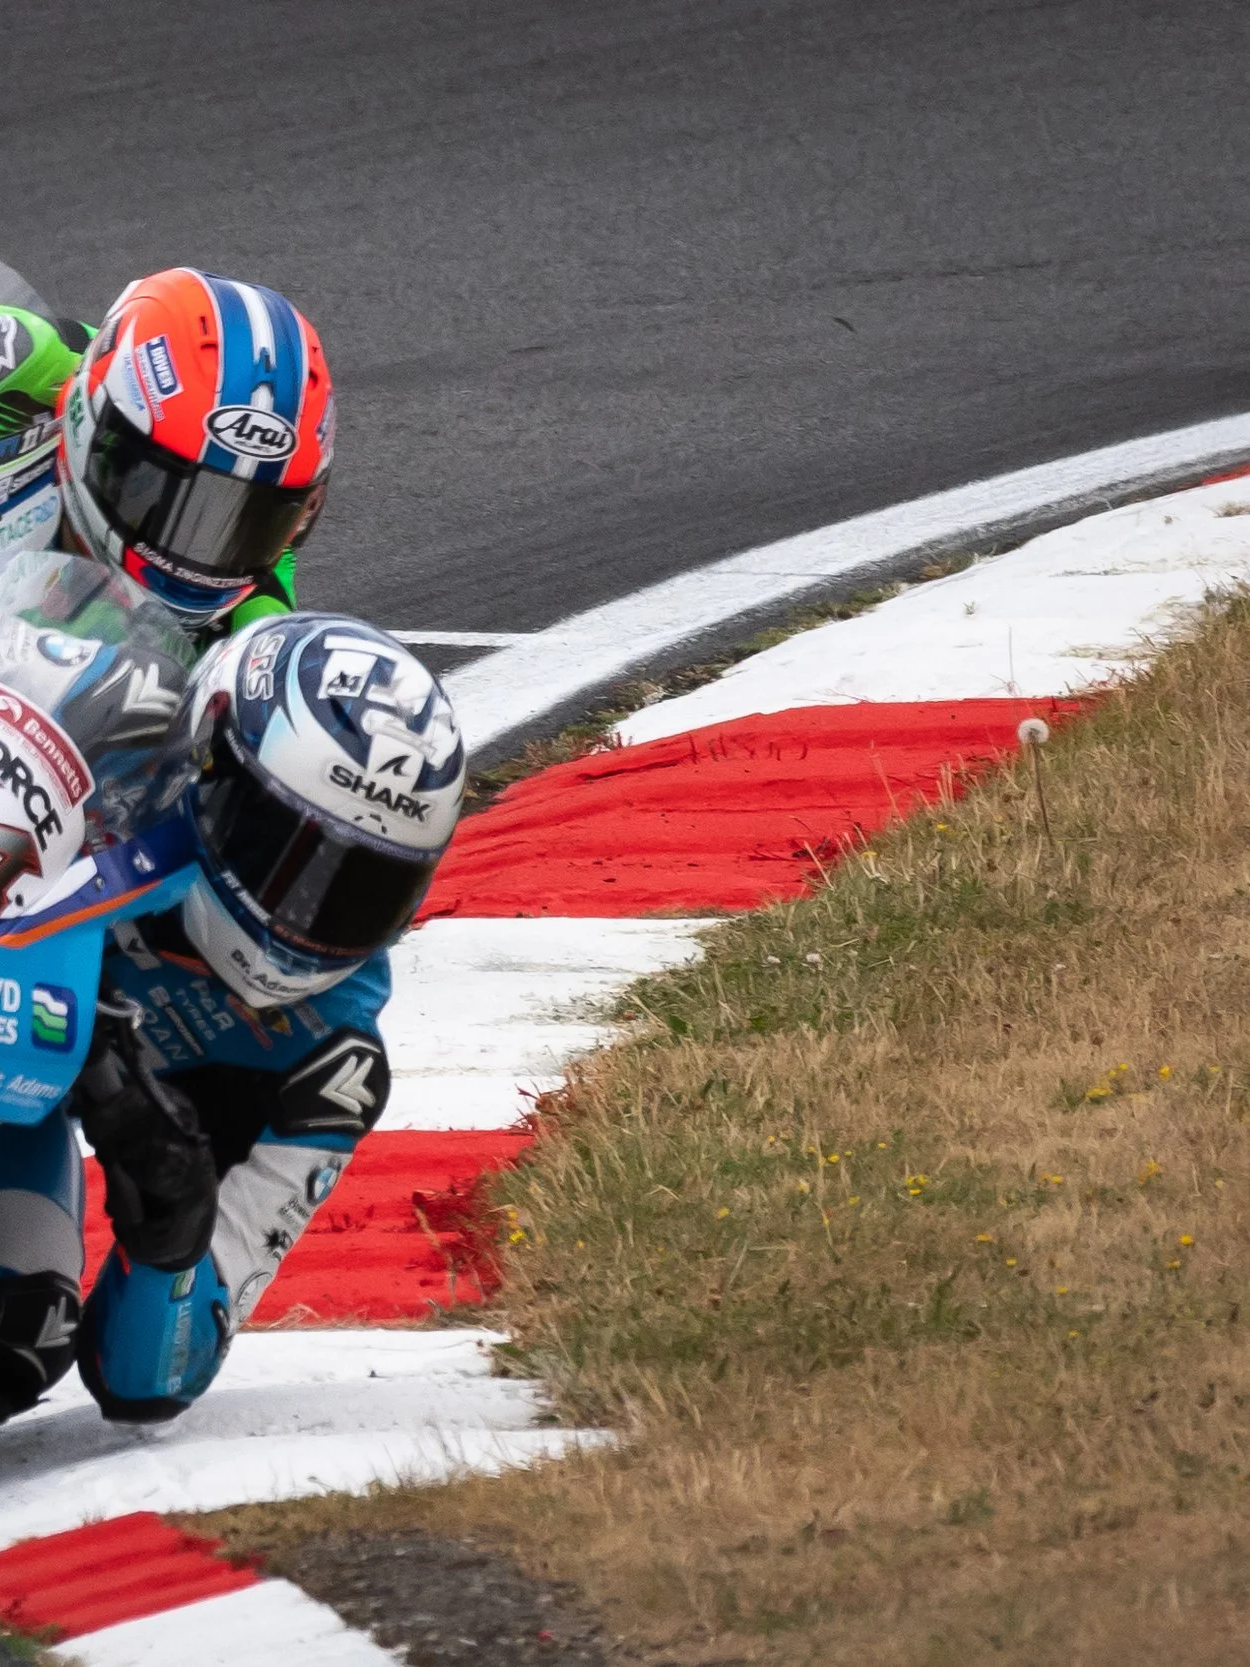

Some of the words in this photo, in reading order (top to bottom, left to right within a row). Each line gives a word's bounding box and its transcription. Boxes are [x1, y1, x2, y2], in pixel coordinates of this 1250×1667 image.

[216, 413, 289, 446] Arai
[25, 712, 82, 799] Bennetts
[329, 764, 431, 822] SHARK
[8, 1074, 63, 1100] Adams
